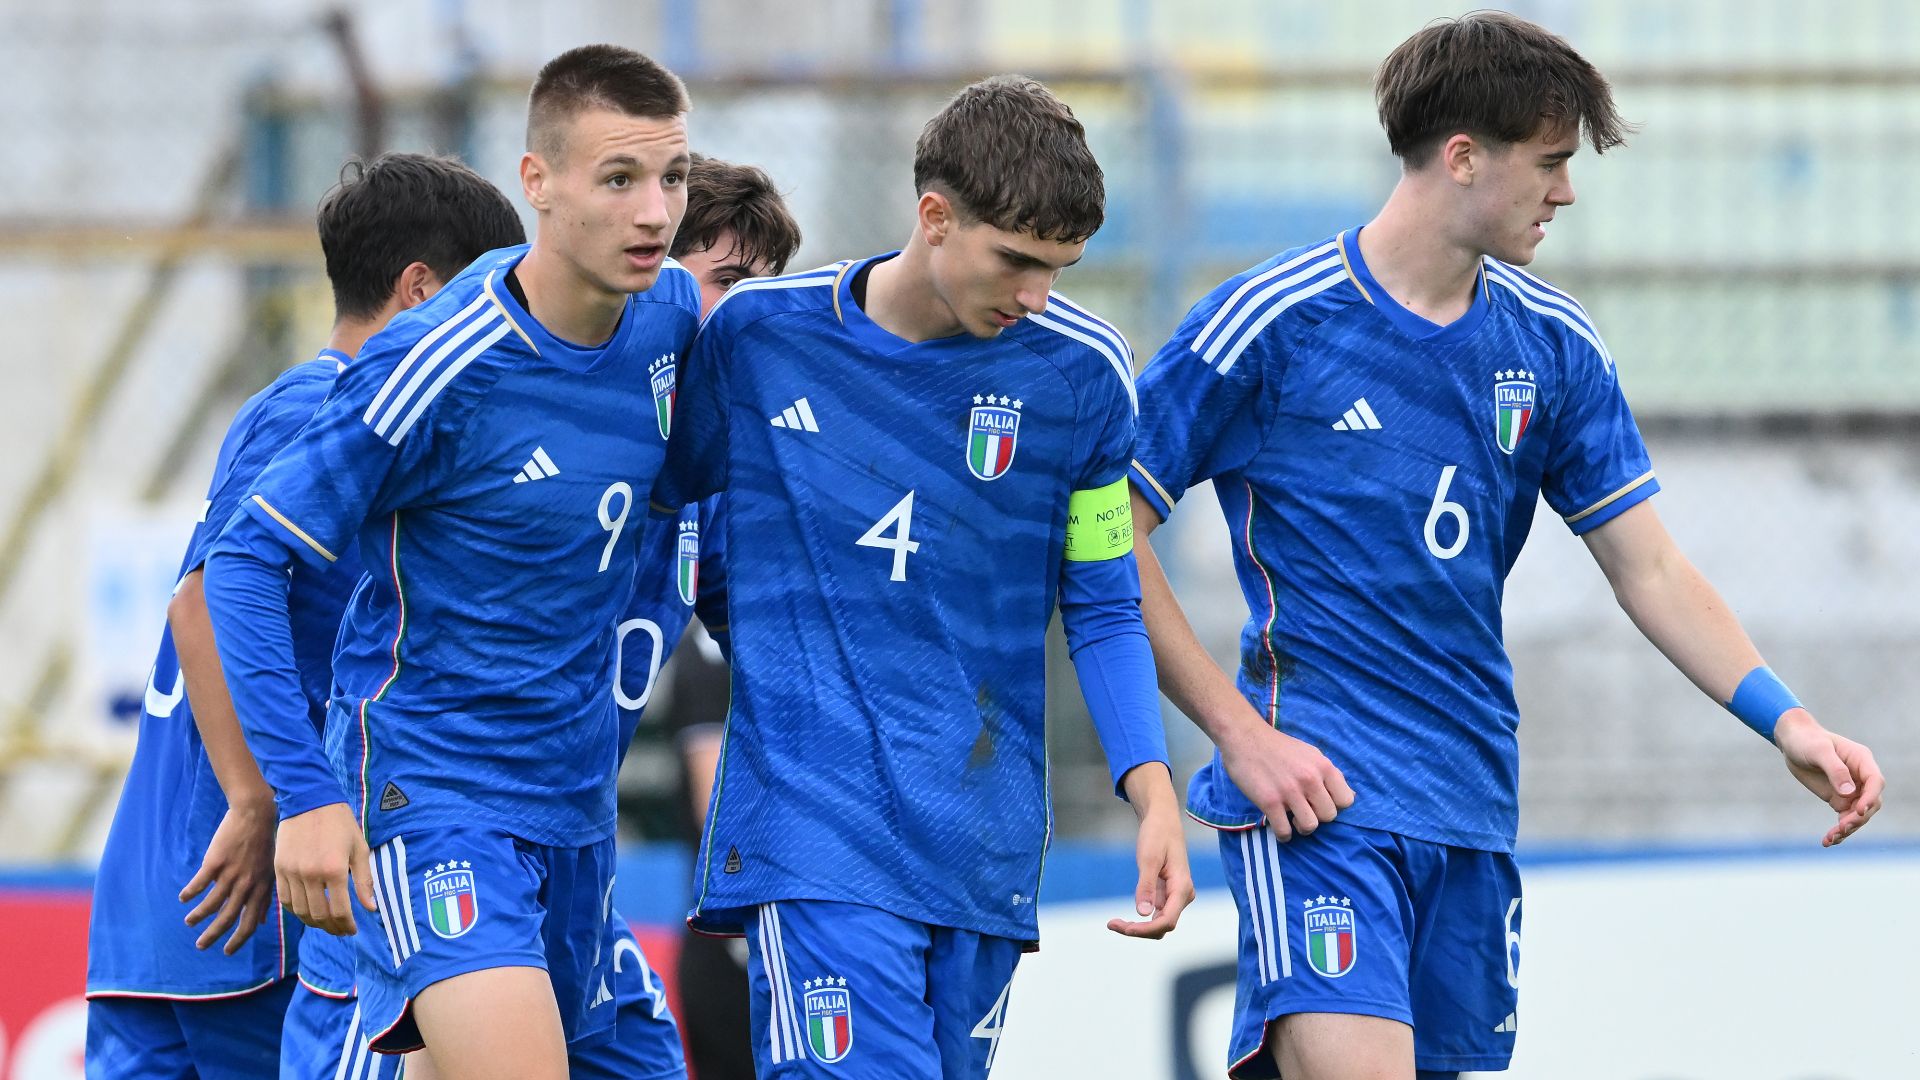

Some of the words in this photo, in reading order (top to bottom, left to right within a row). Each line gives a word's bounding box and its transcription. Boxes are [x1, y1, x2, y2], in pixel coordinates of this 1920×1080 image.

[1499, 388, 1532, 402] ITALIA
[974, 412, 1014, 430] ITALIA
[1066, 514, 1080, 525] M
[1096, 509, 1114, 523] NO
[1115, 504, 1126, 517] TO
[1423, 465, 1470, 560] 6
[597, 481, 633, 573] 9
[854, 489, 921, 582] 4
[612, 618, 664, 711] 0
[428, 875, 470, 896] ITALIA
[1308, 912, 1351, 928] ITALIA
[1504, 897, 1522, 990] 6
[808, 994, 846, 1011] ITALIA
[969, 963, 1018, 1069] 4
